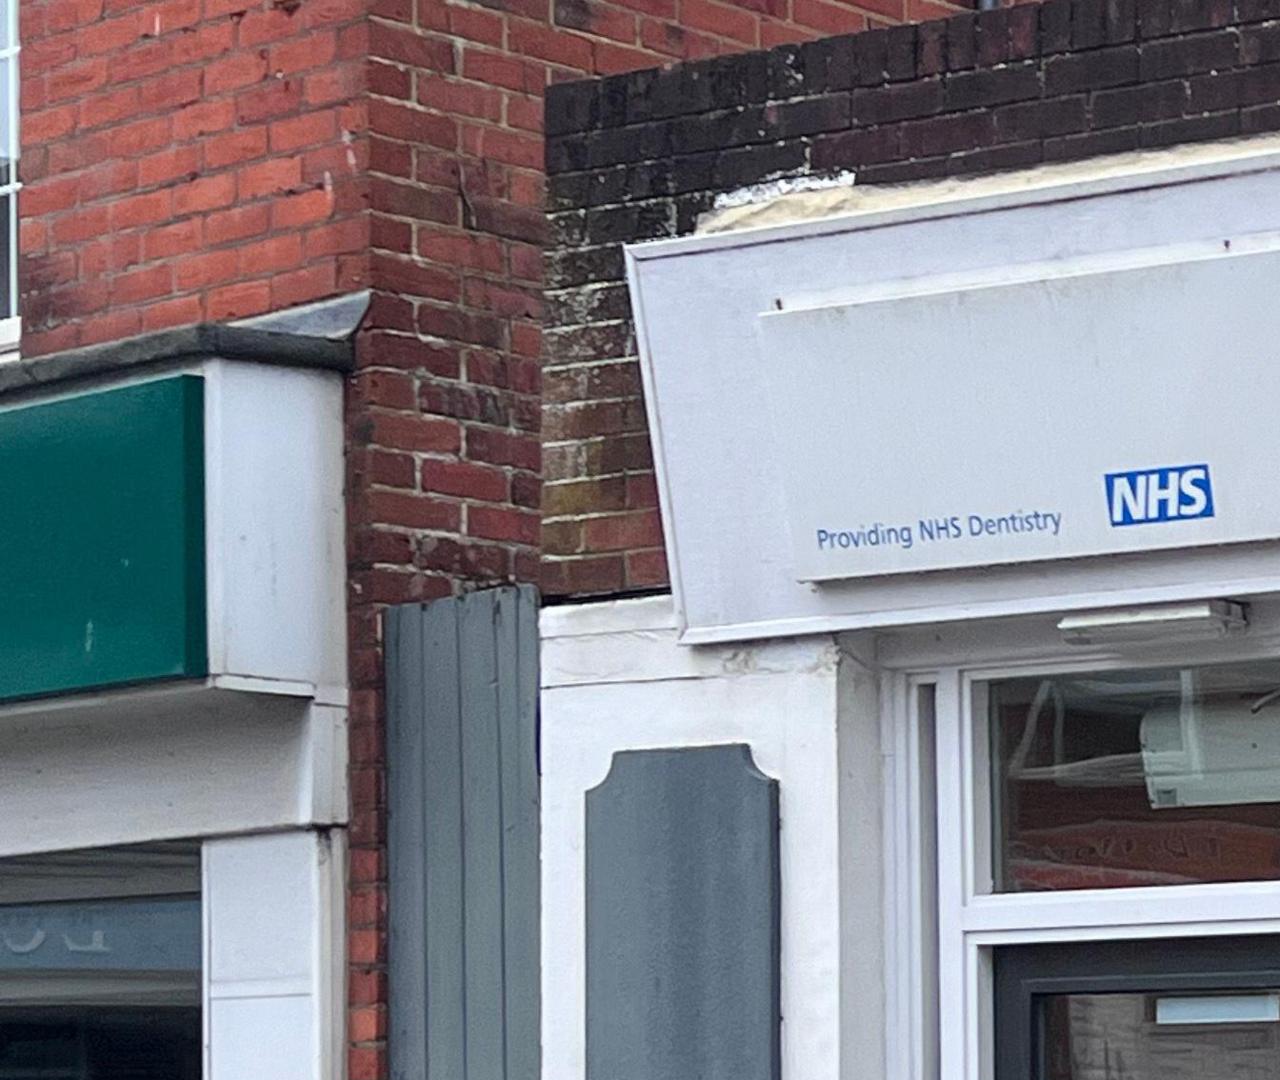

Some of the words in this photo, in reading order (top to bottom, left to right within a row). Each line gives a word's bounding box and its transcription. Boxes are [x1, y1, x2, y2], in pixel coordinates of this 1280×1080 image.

[1111, 468, 1210, 523] NHS
[816, 524, 913, 550] Providing
[918, 516, 962, 542] NHS
[969, 508, 1063, 538] Dentistry
